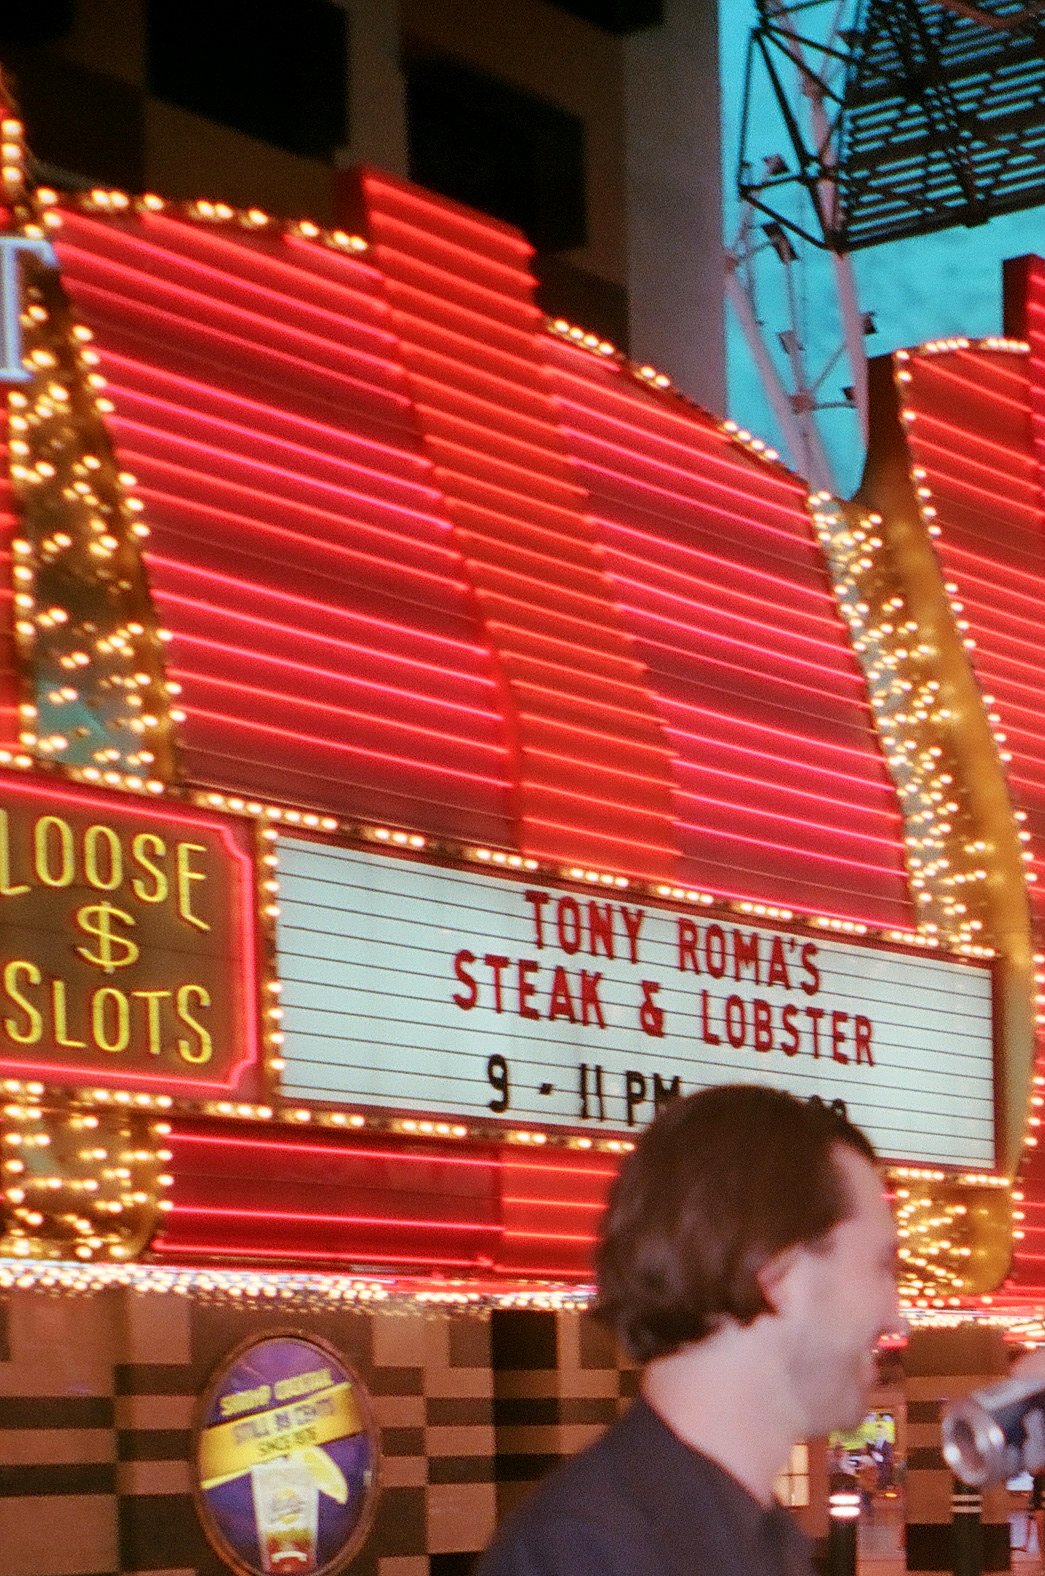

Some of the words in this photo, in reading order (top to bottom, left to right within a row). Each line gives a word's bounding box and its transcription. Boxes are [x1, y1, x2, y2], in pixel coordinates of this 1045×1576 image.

[0, 808, 212, 931] LOOSE
[525, 889, 646, 964] TONY
[677, 918, 821, 996] ROMA'S
[3, 961, 213, 1064] SLOTS
[451, 949, 607, 1029] STEAK
[640, 979, 666, 1037] &
[700, 989, 876, 1067] LOBSTER
[487, 1053, 509, 1113] 9
